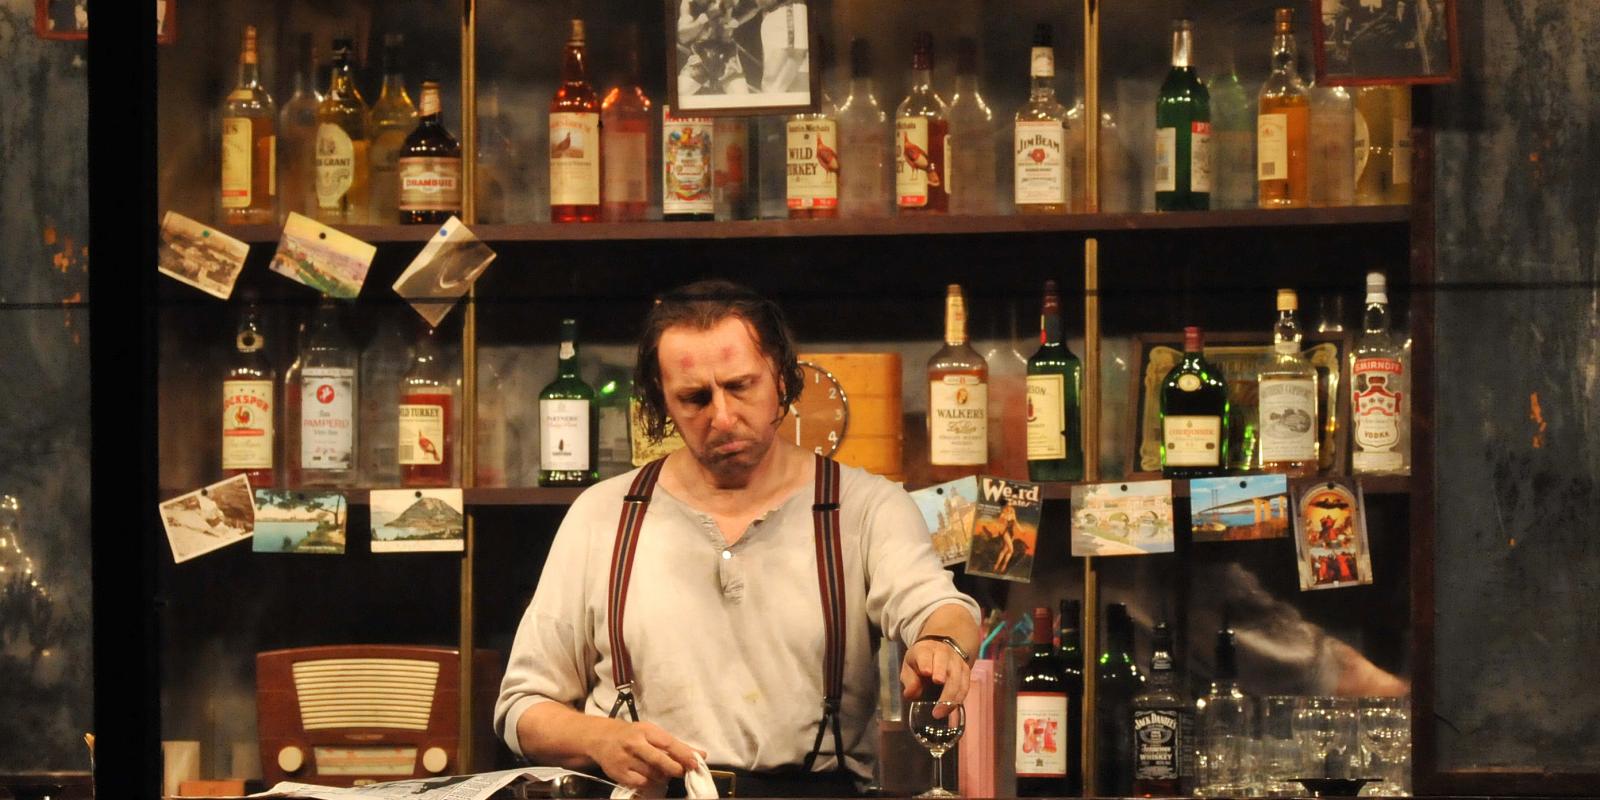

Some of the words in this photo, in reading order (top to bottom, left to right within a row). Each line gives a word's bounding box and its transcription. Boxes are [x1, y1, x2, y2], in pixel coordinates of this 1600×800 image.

[1017, 136, 1034, 154] JIM
[1035, 134, 1060, 153] BEAM
[789, 147, 813, 160] WILD
[815, 373, 820, 384] 1
[829, 387, 837, 400] 2
[224, 395, 270, 413] OCKSPUR
[411, 408, 439, 417] TURKEY
[835, 408, 843, 421] 3
[828, 431, 838, 445] 4
[1364, 431, 1390, 439] VODKA
